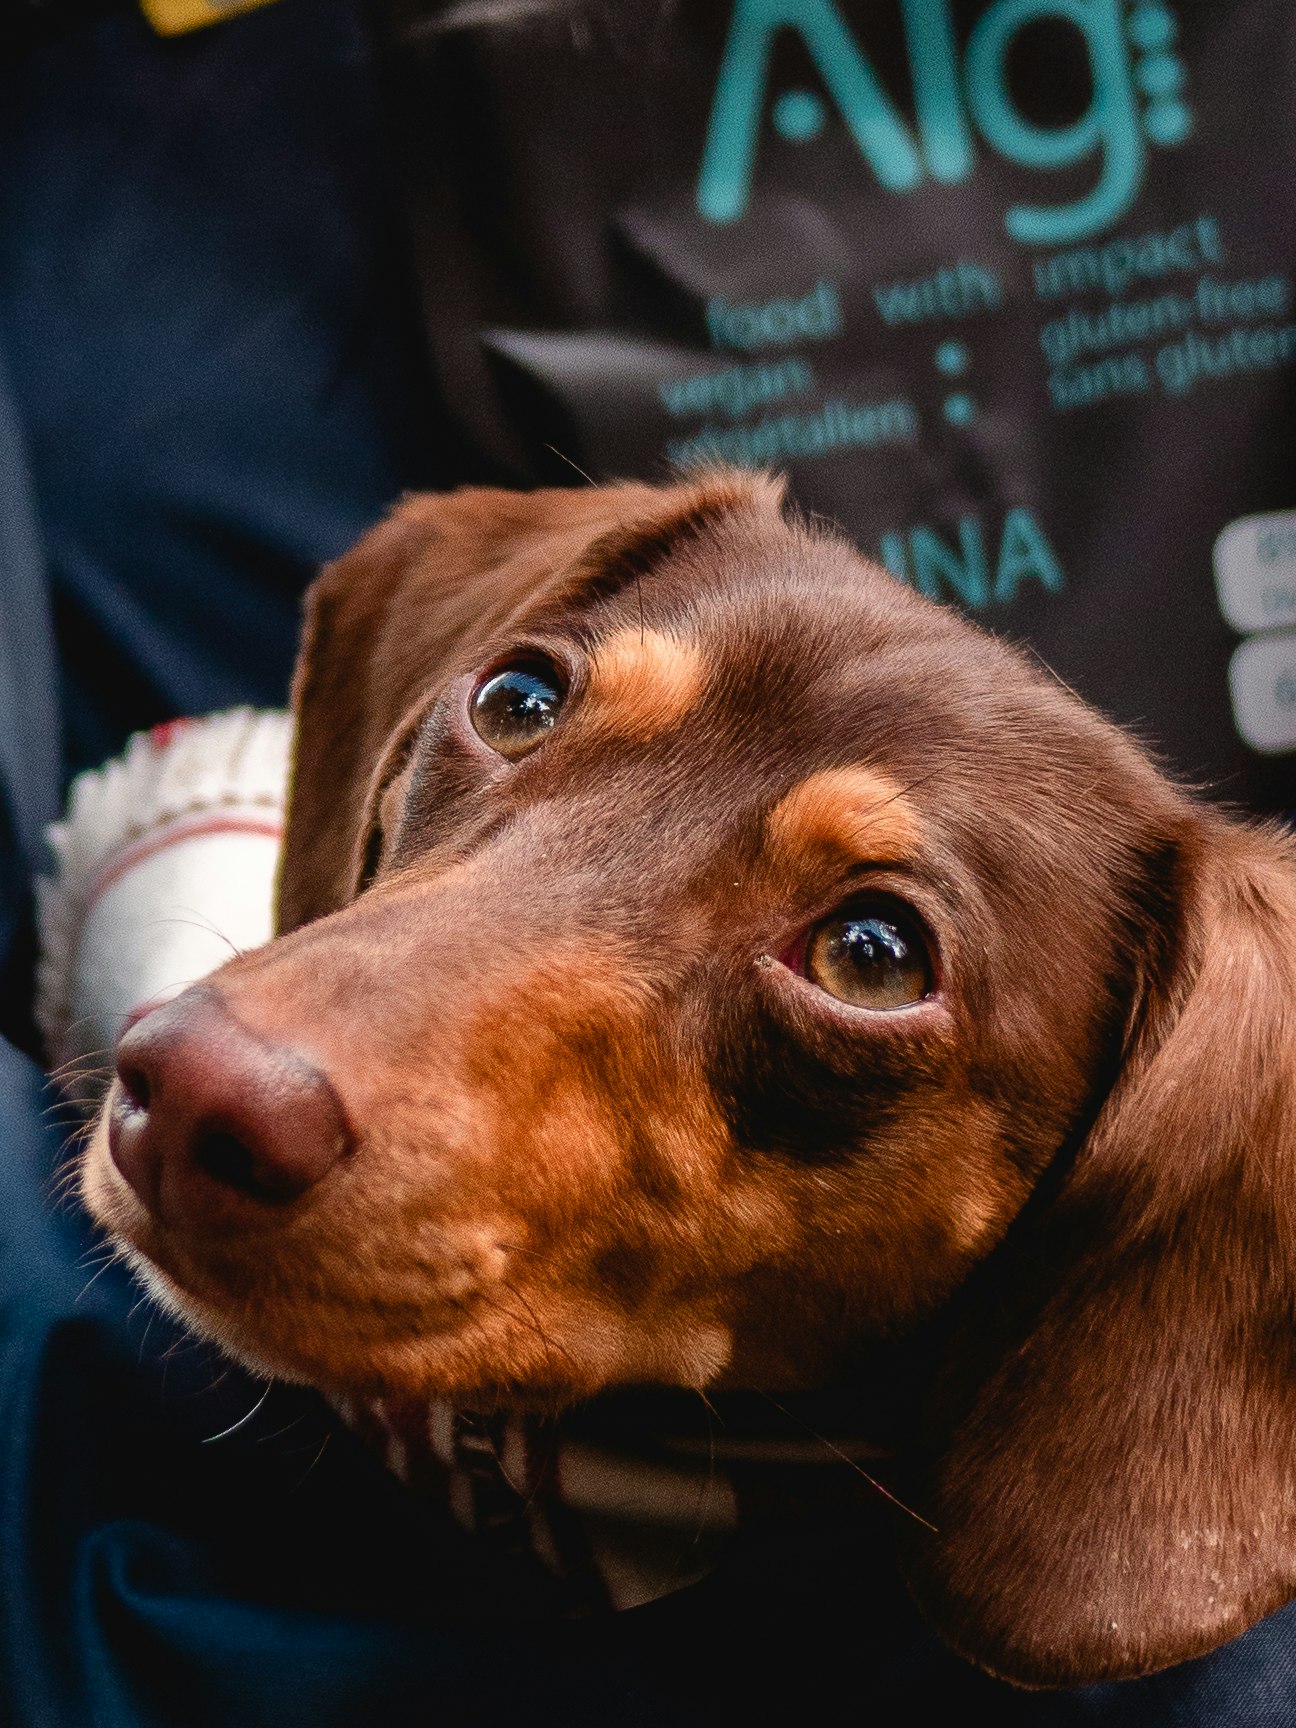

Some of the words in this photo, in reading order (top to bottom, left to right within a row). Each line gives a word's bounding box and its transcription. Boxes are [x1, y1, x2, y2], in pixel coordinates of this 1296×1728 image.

[707, 280, 842, 352] food
[872, 262, 1003, 323] with
[1033, 216, 1222, 297] impact
[659, 356, 815, 418] vegan
